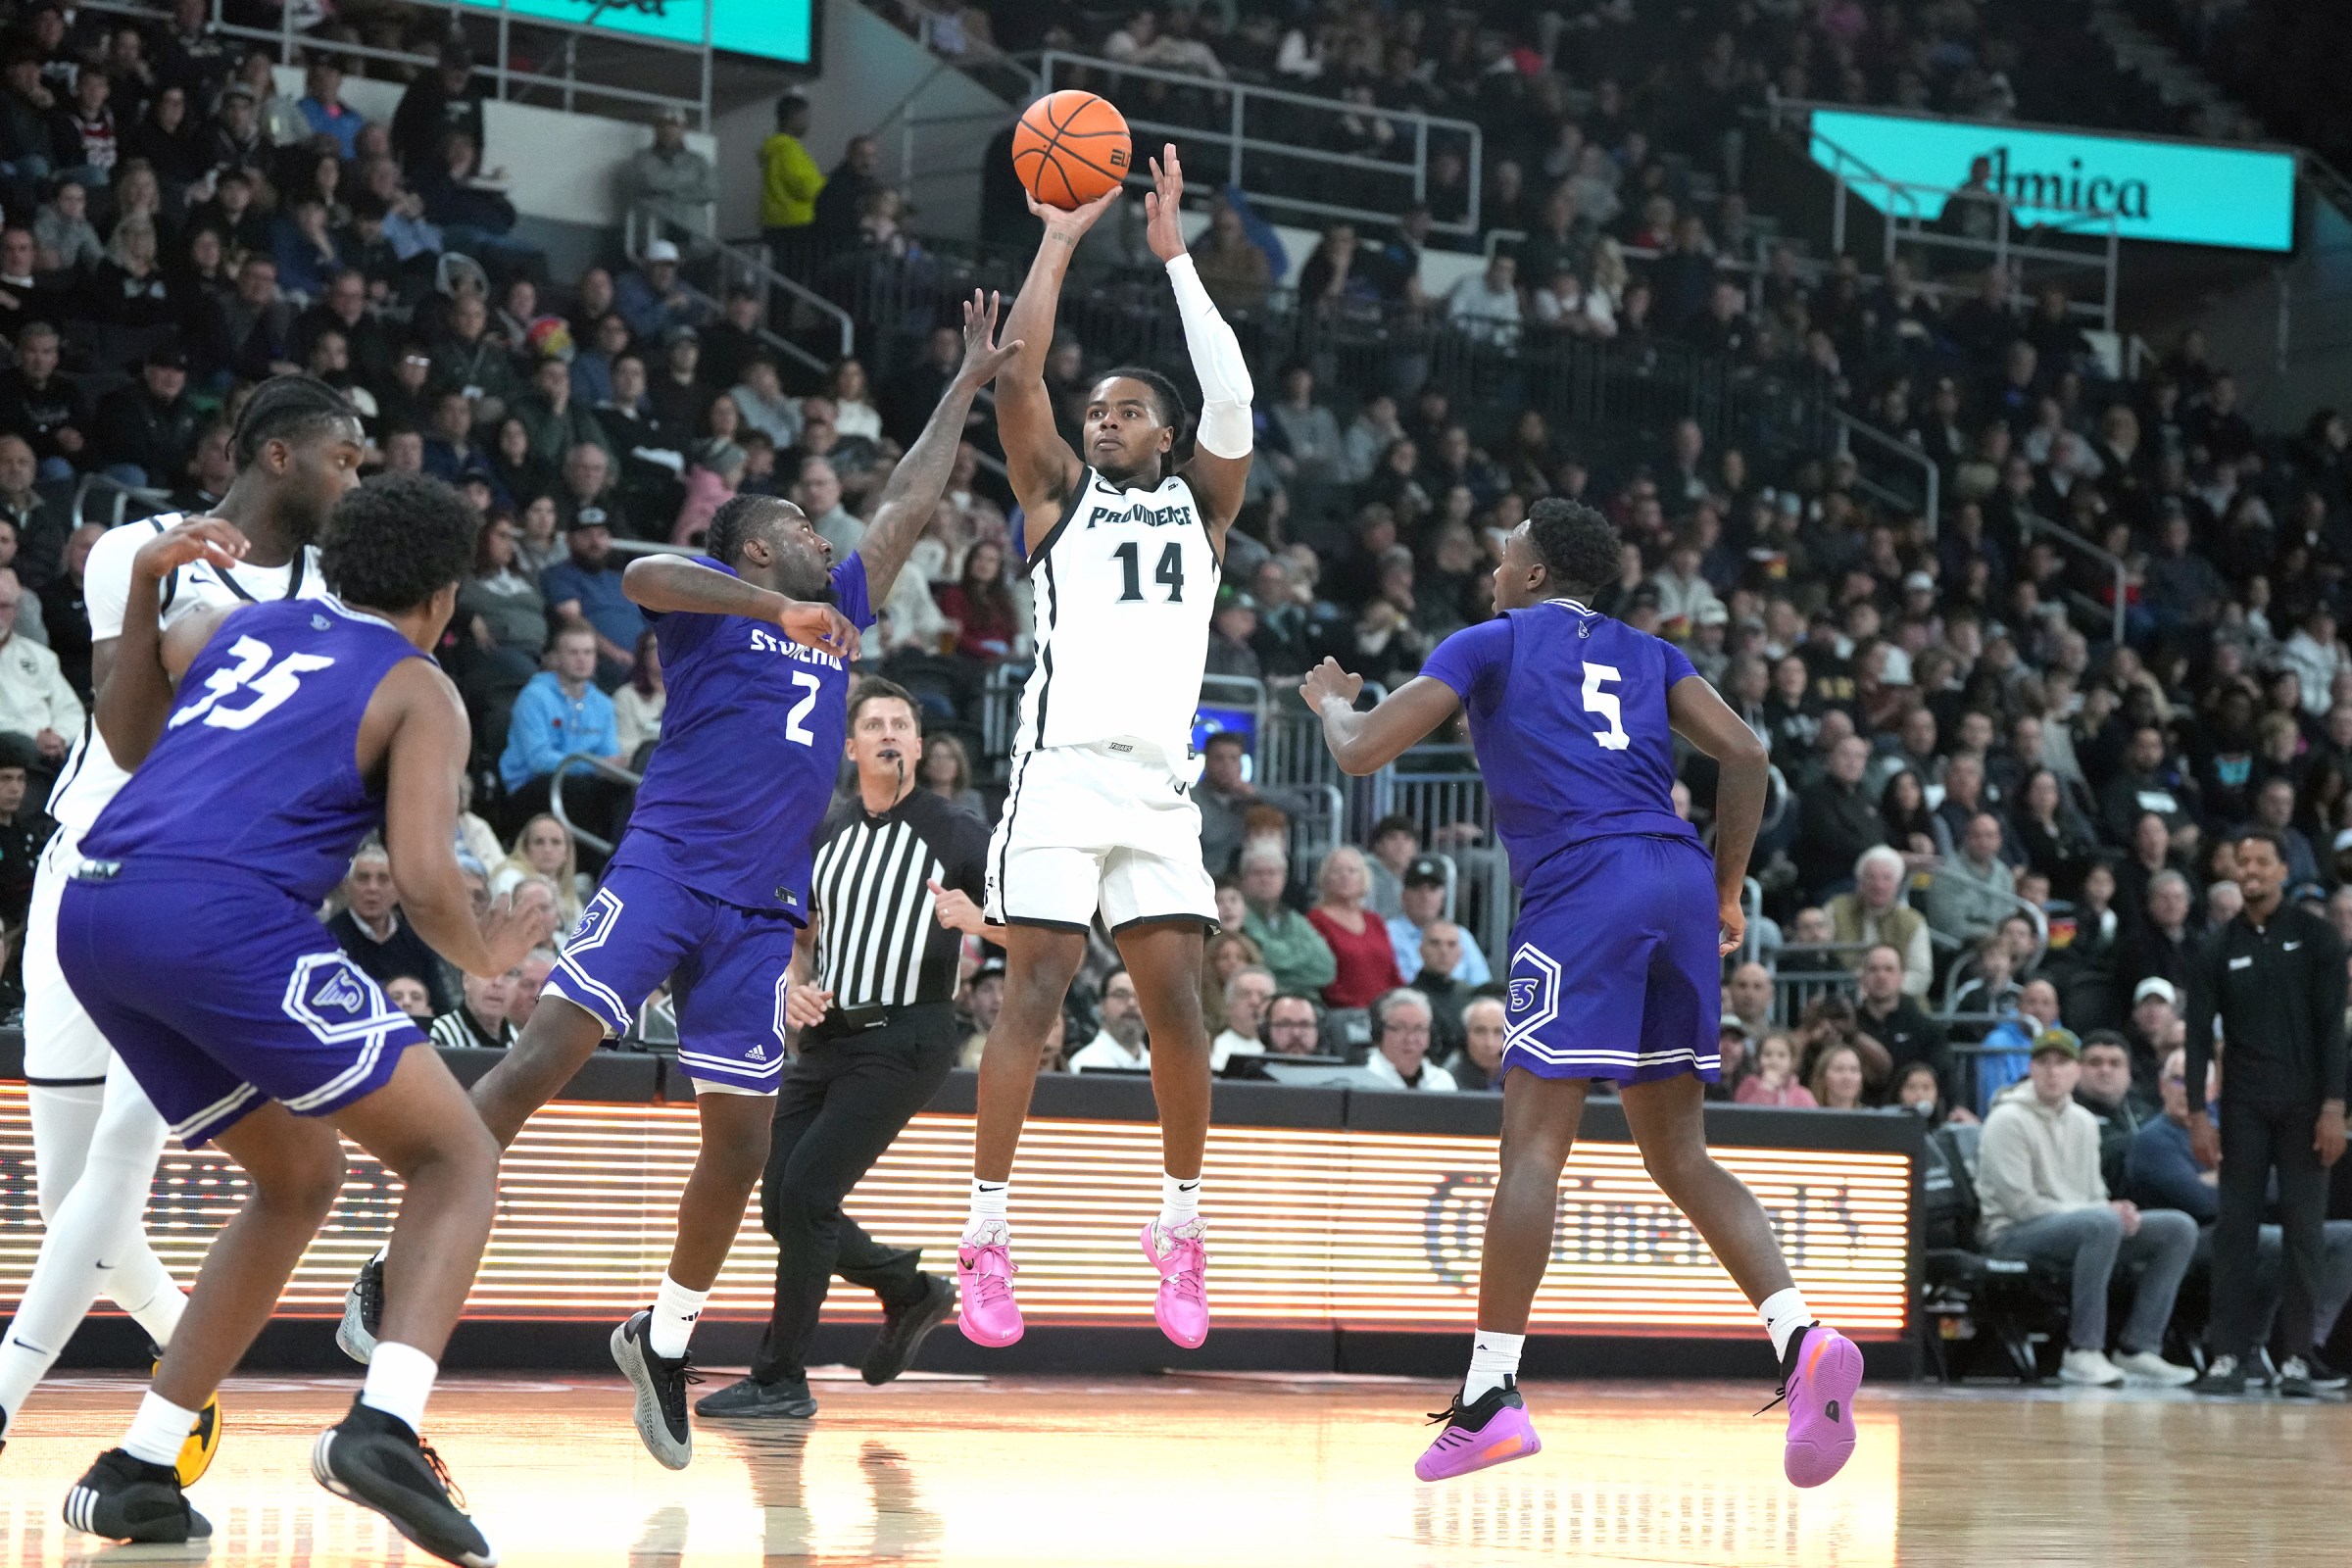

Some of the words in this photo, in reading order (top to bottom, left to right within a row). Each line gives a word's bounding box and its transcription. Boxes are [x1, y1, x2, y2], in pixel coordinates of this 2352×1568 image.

[1086, 503, 1193, 530] PROVIDENCE
[1108, 540, 1185, 605] 14
[168, 634, 336, 731] 35
[785, 669, 821, 747] 2
[1581, 660, 1631, 751] 5
[745, 1053, 767, 1061] adidas
